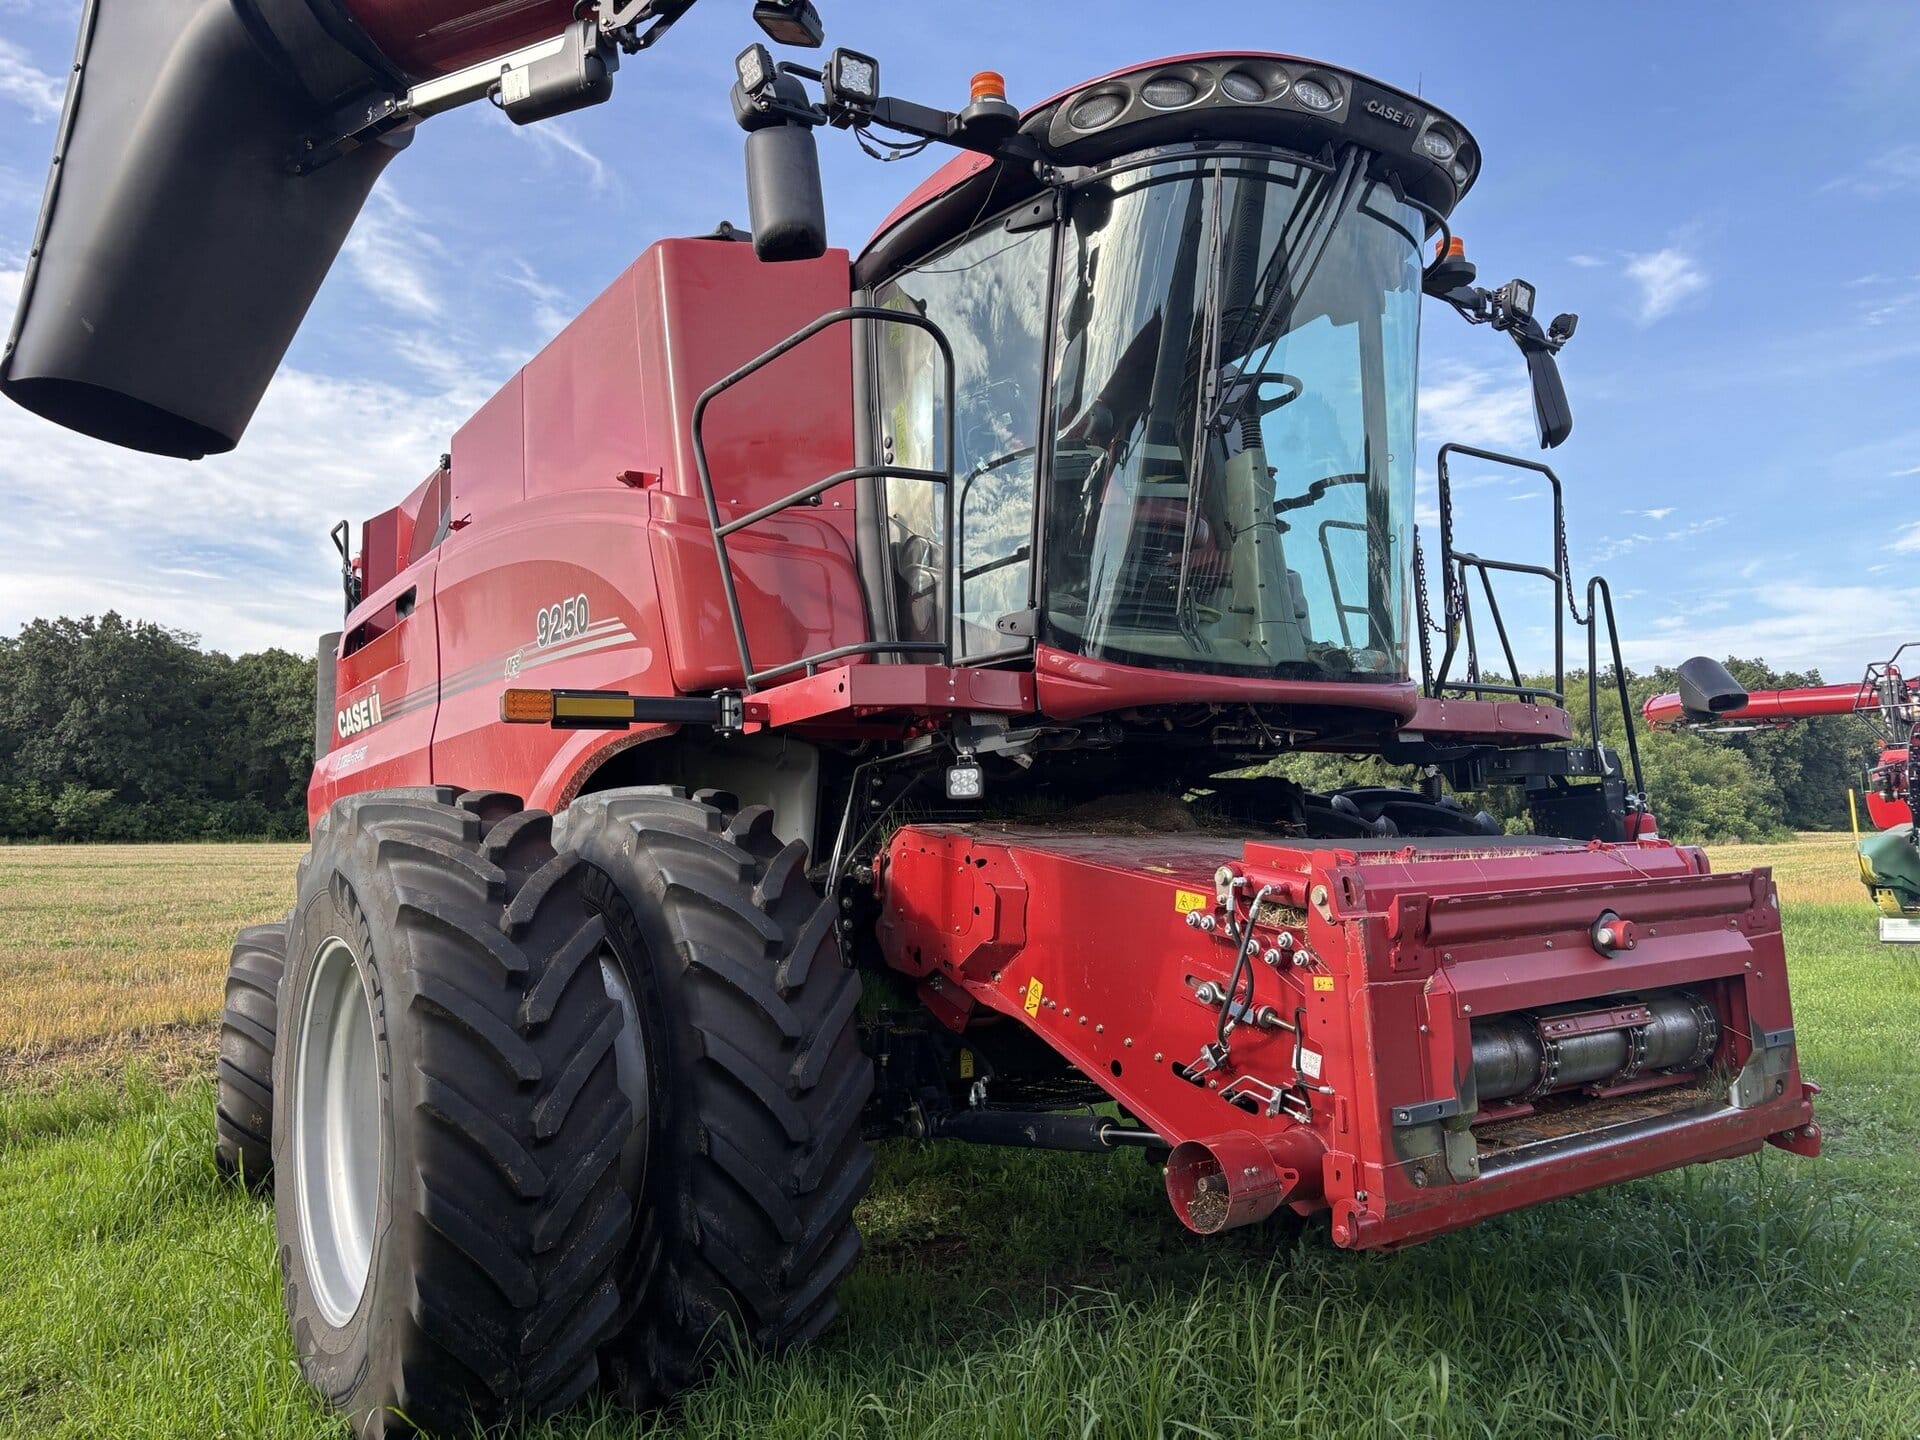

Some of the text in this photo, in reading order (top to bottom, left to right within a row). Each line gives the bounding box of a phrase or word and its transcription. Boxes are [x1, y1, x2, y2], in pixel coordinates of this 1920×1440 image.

[1367, 100, 1402, 122] CASE
[537, 593, 589, 649] 9250
[337, 698, 370, 738] CASE
